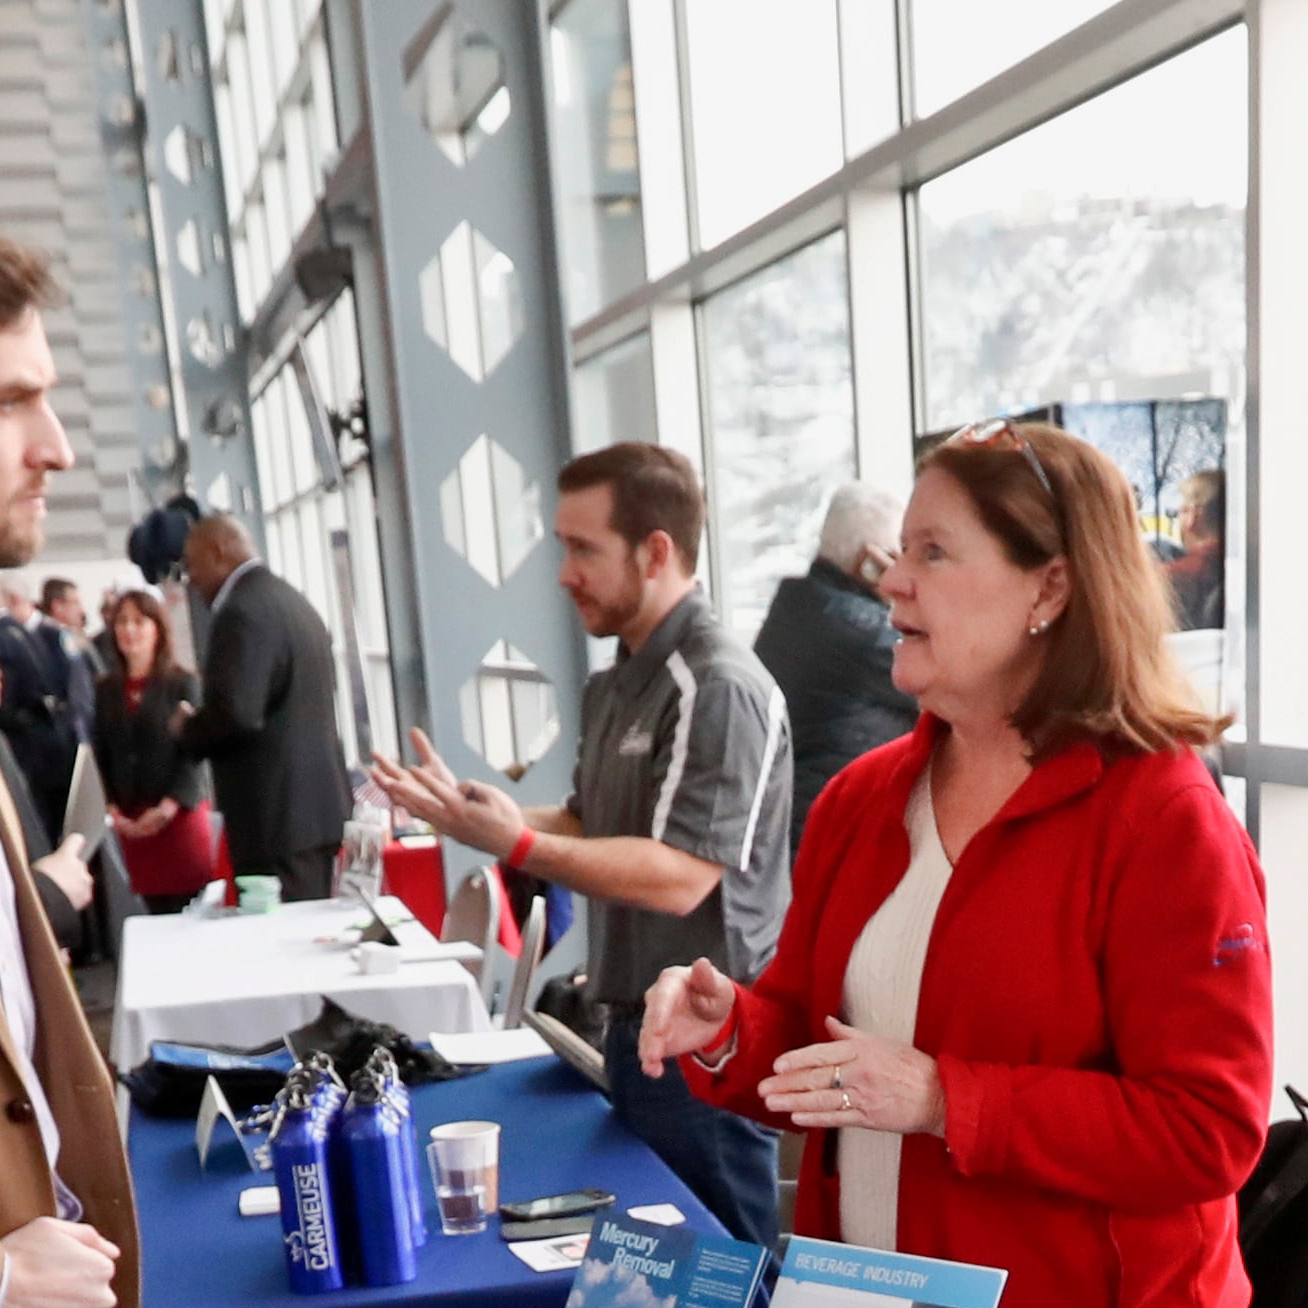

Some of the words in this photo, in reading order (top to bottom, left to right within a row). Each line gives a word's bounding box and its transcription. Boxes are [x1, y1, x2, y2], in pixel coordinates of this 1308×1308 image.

[297, 1162, 330, 1271] CARMEUSE
[599, 1221, 661, 1257] Mercury
[612, 1247, 676, 1280] Removal
[795, 1252, 862, 1278] BEVERAGE
[862, 1266, 929, 1289] INDUSTRY
